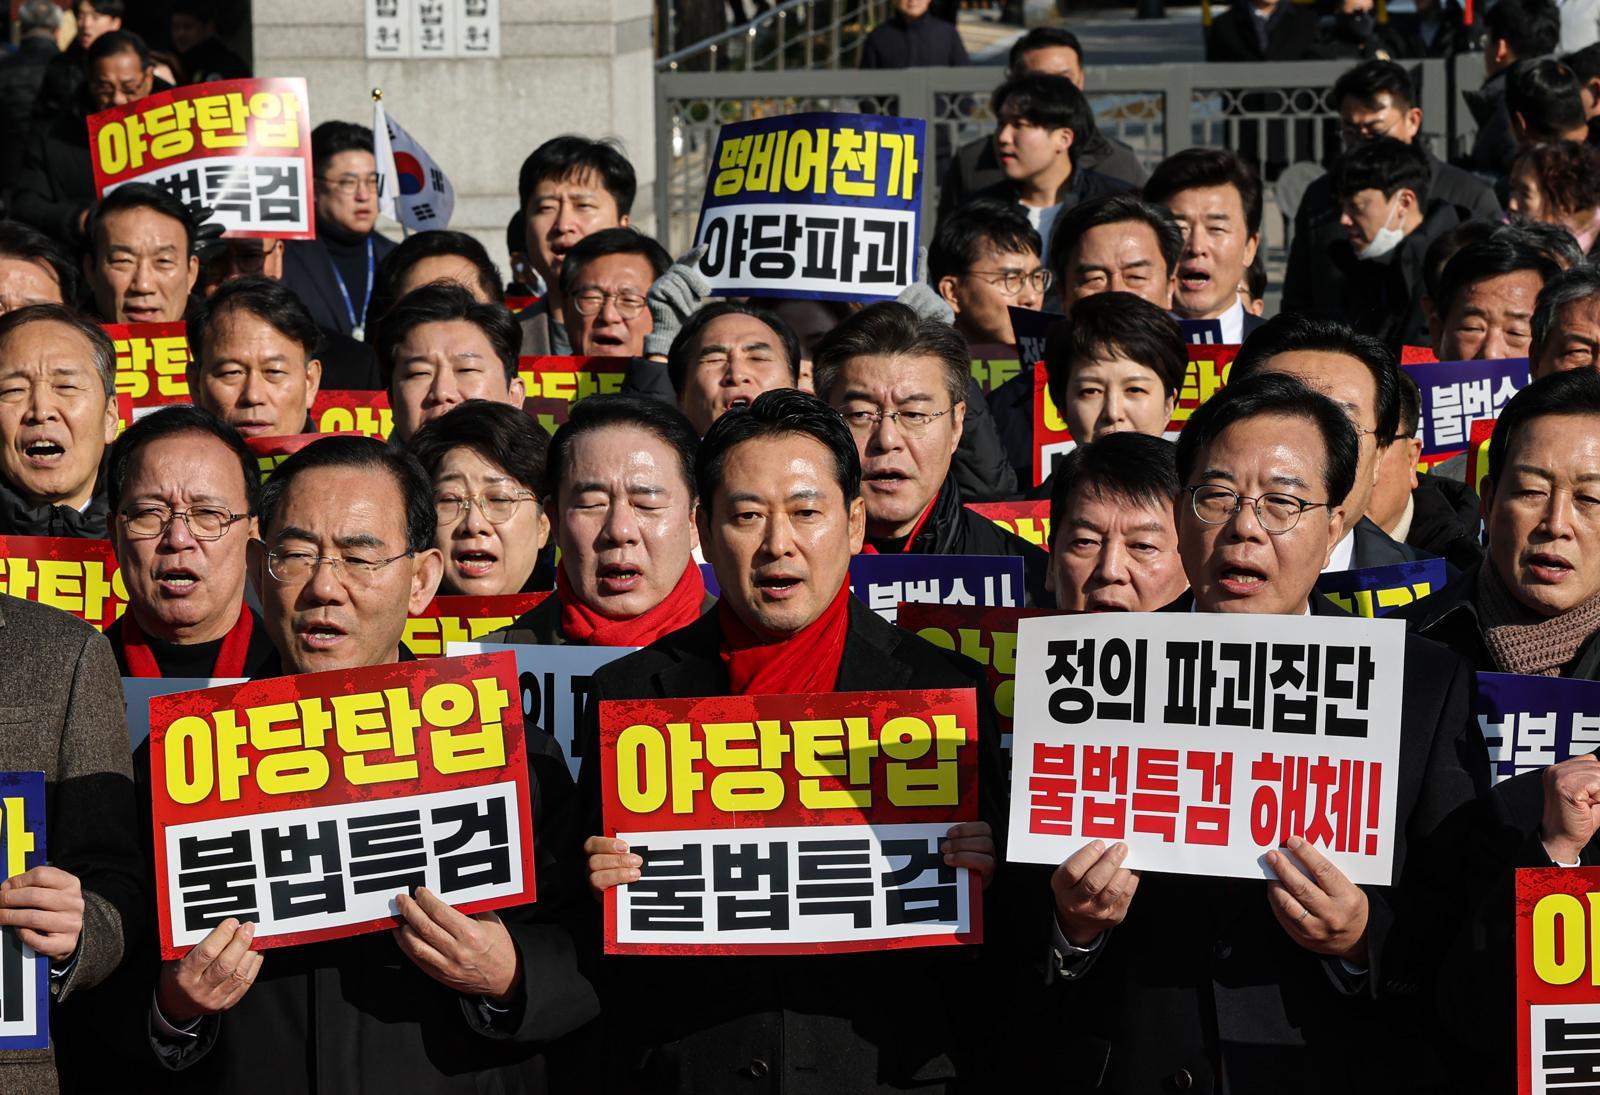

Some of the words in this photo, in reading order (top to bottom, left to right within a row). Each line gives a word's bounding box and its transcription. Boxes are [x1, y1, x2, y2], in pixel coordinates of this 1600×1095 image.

[97, 92, 300, 175] 야당탄압
[713, 128, 918, 200] 명비어천가
[701, 214, 908, 287] 야당파괴
[1045, 637, 1147, 725] 정의
[1163, 641, 1375, 738] 파괴집단
[164, 678, 509, 805] 야당탄압
[616, 714, 967, 815] 야당탄압
[1028, 743, 1233, 847] 불법특검
[1250, 752, 1382, 856] 해체!
[179, 797, 511, 932] 불법특검
[628, 839, 958, 932] 불법특검
